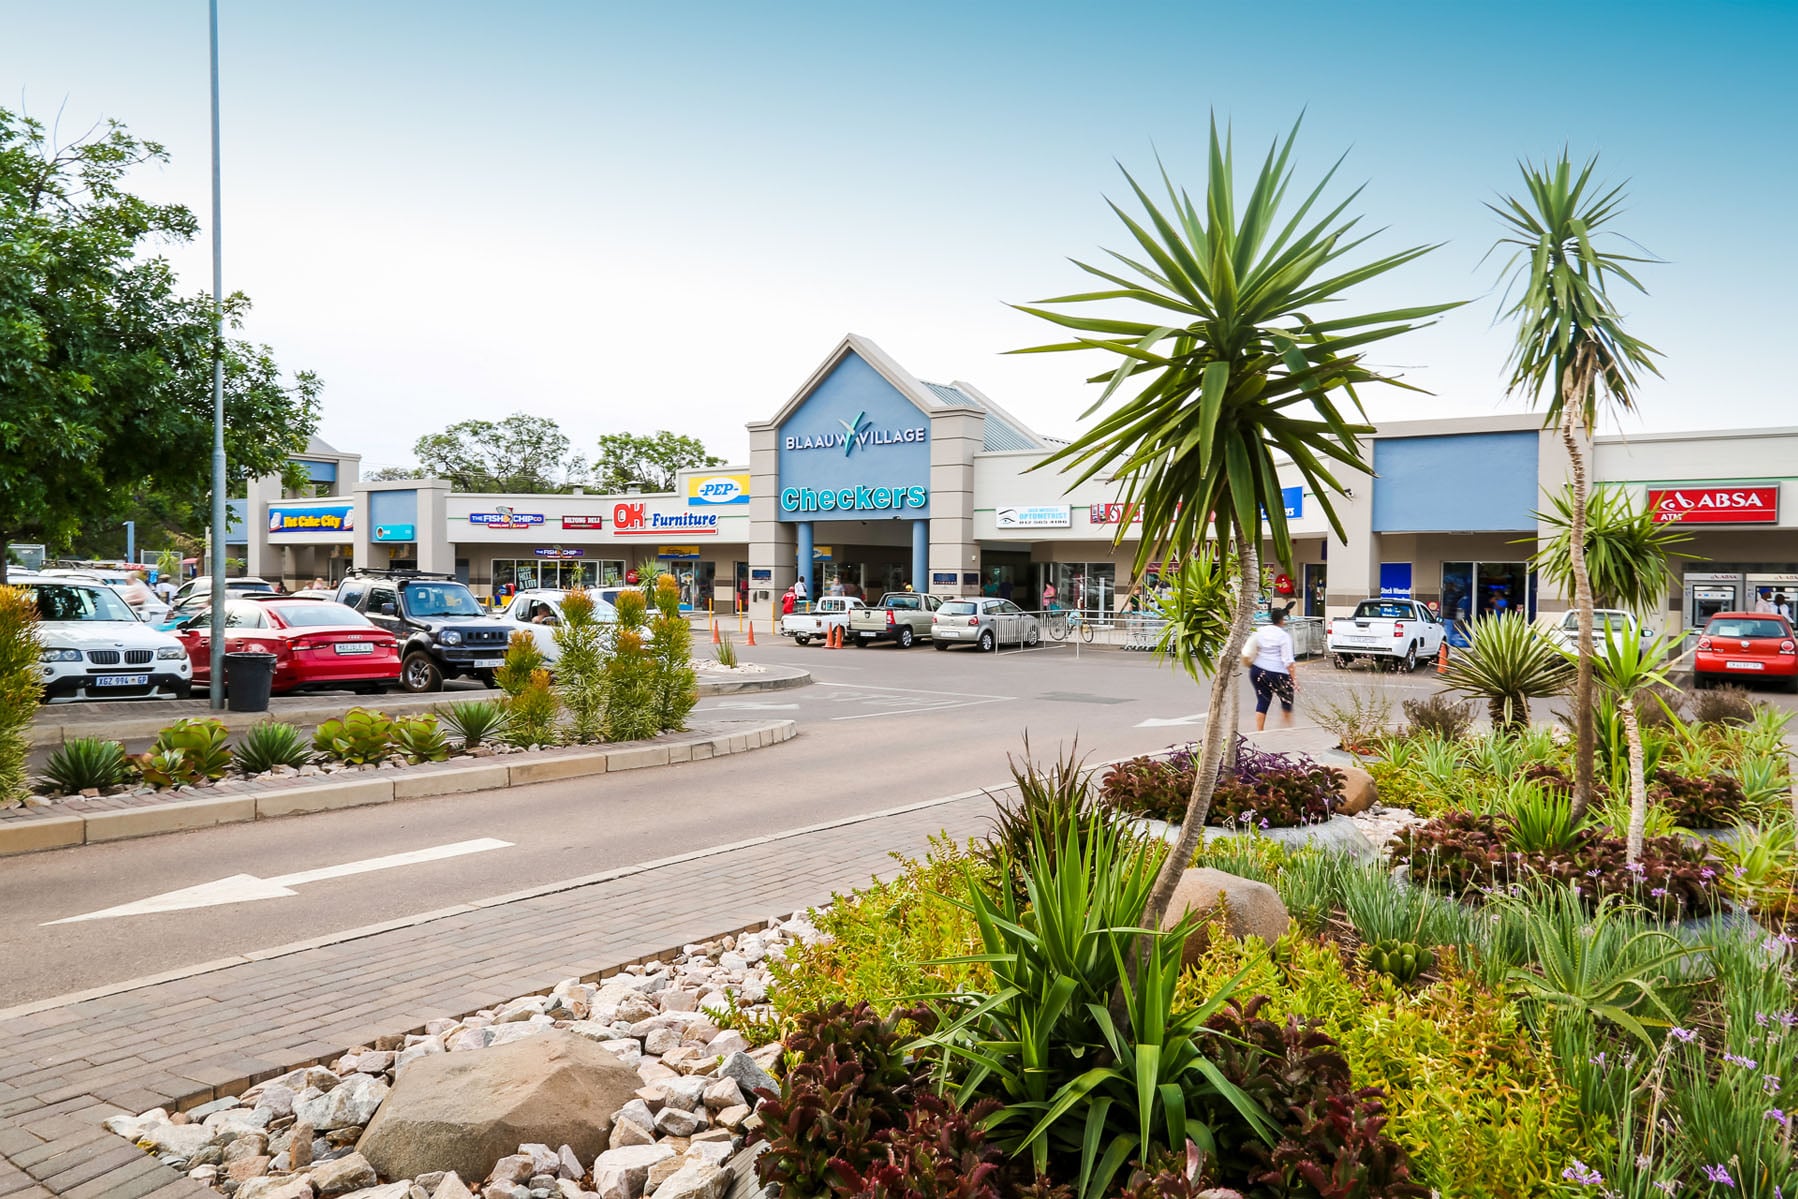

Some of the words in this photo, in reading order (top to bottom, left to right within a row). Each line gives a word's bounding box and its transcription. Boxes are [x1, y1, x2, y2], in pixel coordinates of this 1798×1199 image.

[785, 433, 846, 450] BLAAUW
[859, 427, 925, 445] VILLAGE
[780, 485, 926, 511] Checkers
[1697, 492, 1763, 508] ABSA
[321, 514, 342, 529] City
[483, 515, 503, 523] FISH
[513, 515, 534, 523] CHIP
[613, 503, 645, 529] OK
[652, 512, 717, 527] Furniture
[1660, 513, 1682, 521] ATM
[137, 676, 146, 684] GP
